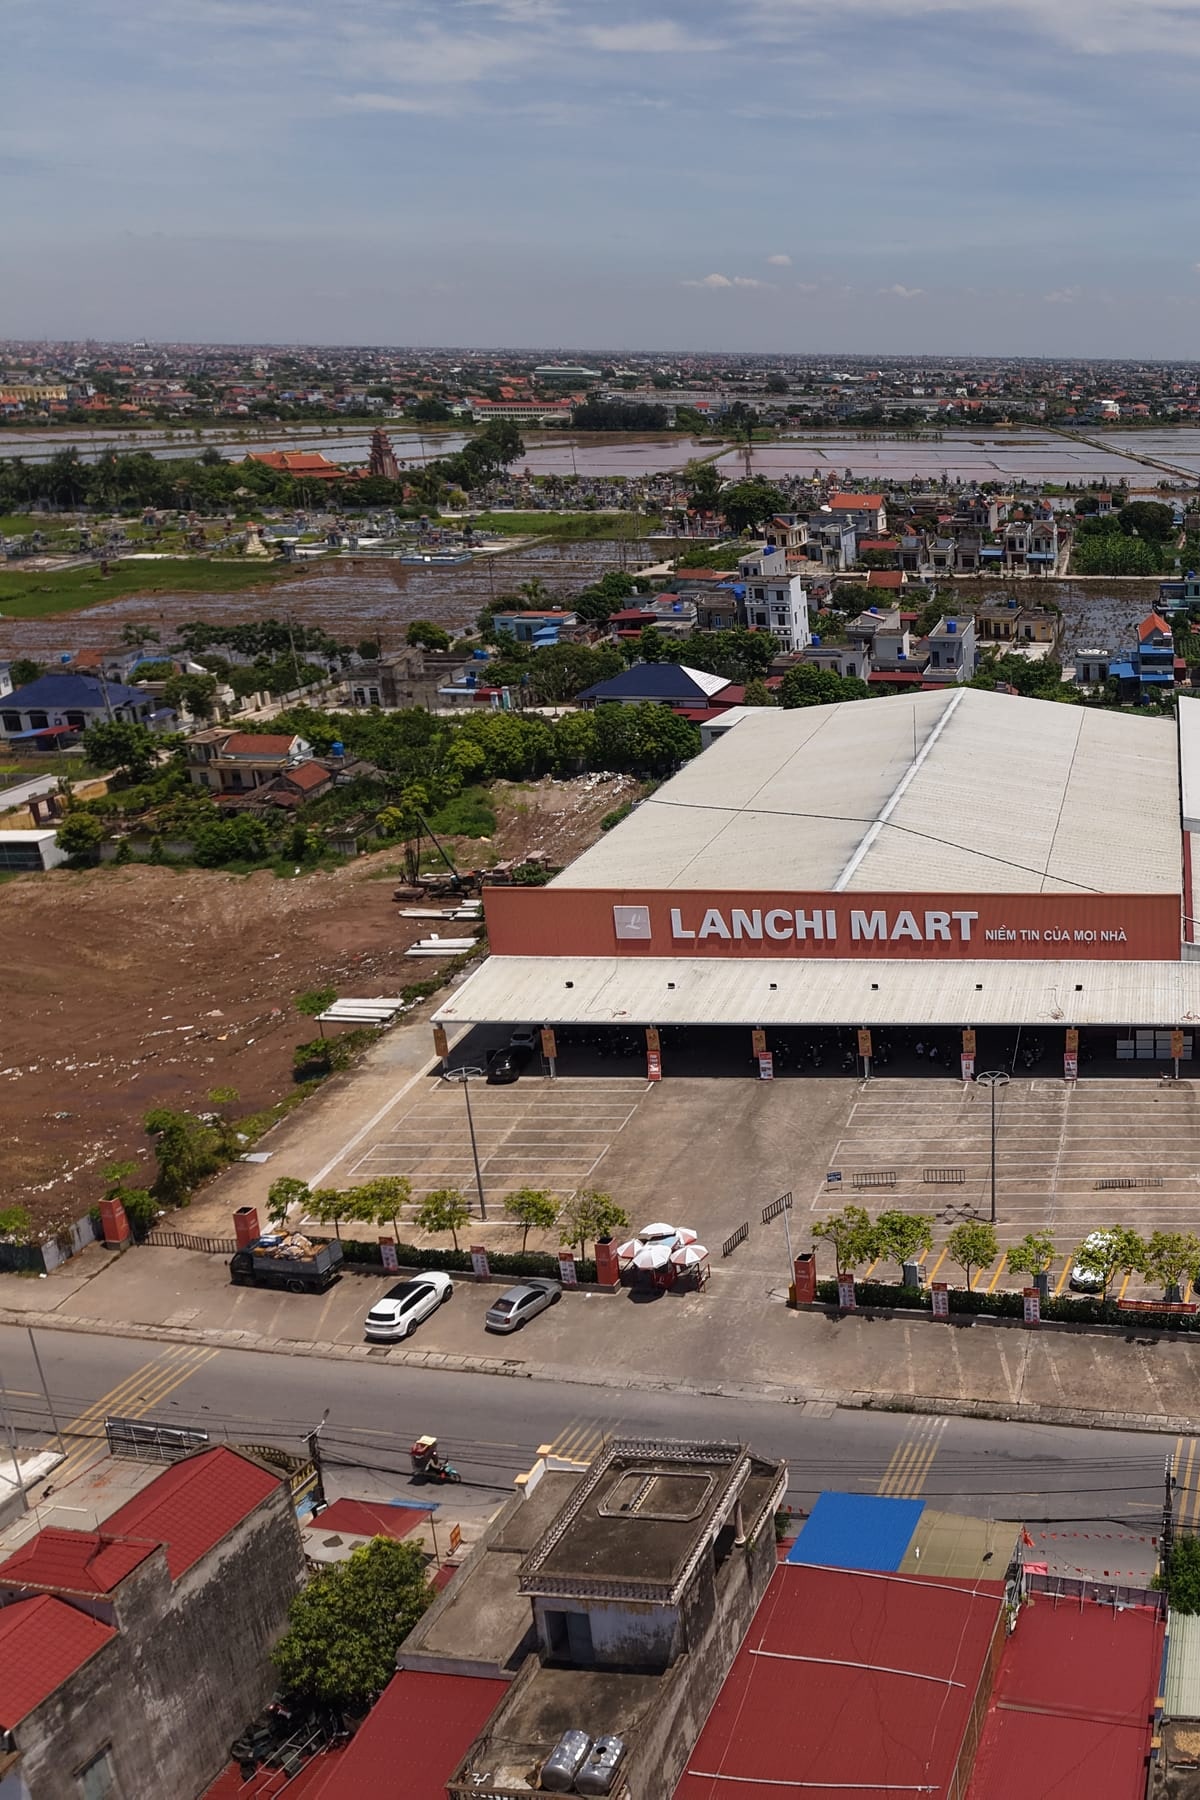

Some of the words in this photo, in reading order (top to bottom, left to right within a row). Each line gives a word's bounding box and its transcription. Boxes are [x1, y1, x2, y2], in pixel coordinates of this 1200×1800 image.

[670, 908, 837, 940] LANCHI
[850, 910, 979, 941] MART
[985, 924, 1017, 941] NIỀM
[1019, 929, 1040, 941] TIN
[1043, 926, 1071, 941] CỦA
[1074, 929, 1097, 945] MỌI
[1100, 927, 1128, 941] NHÀ
